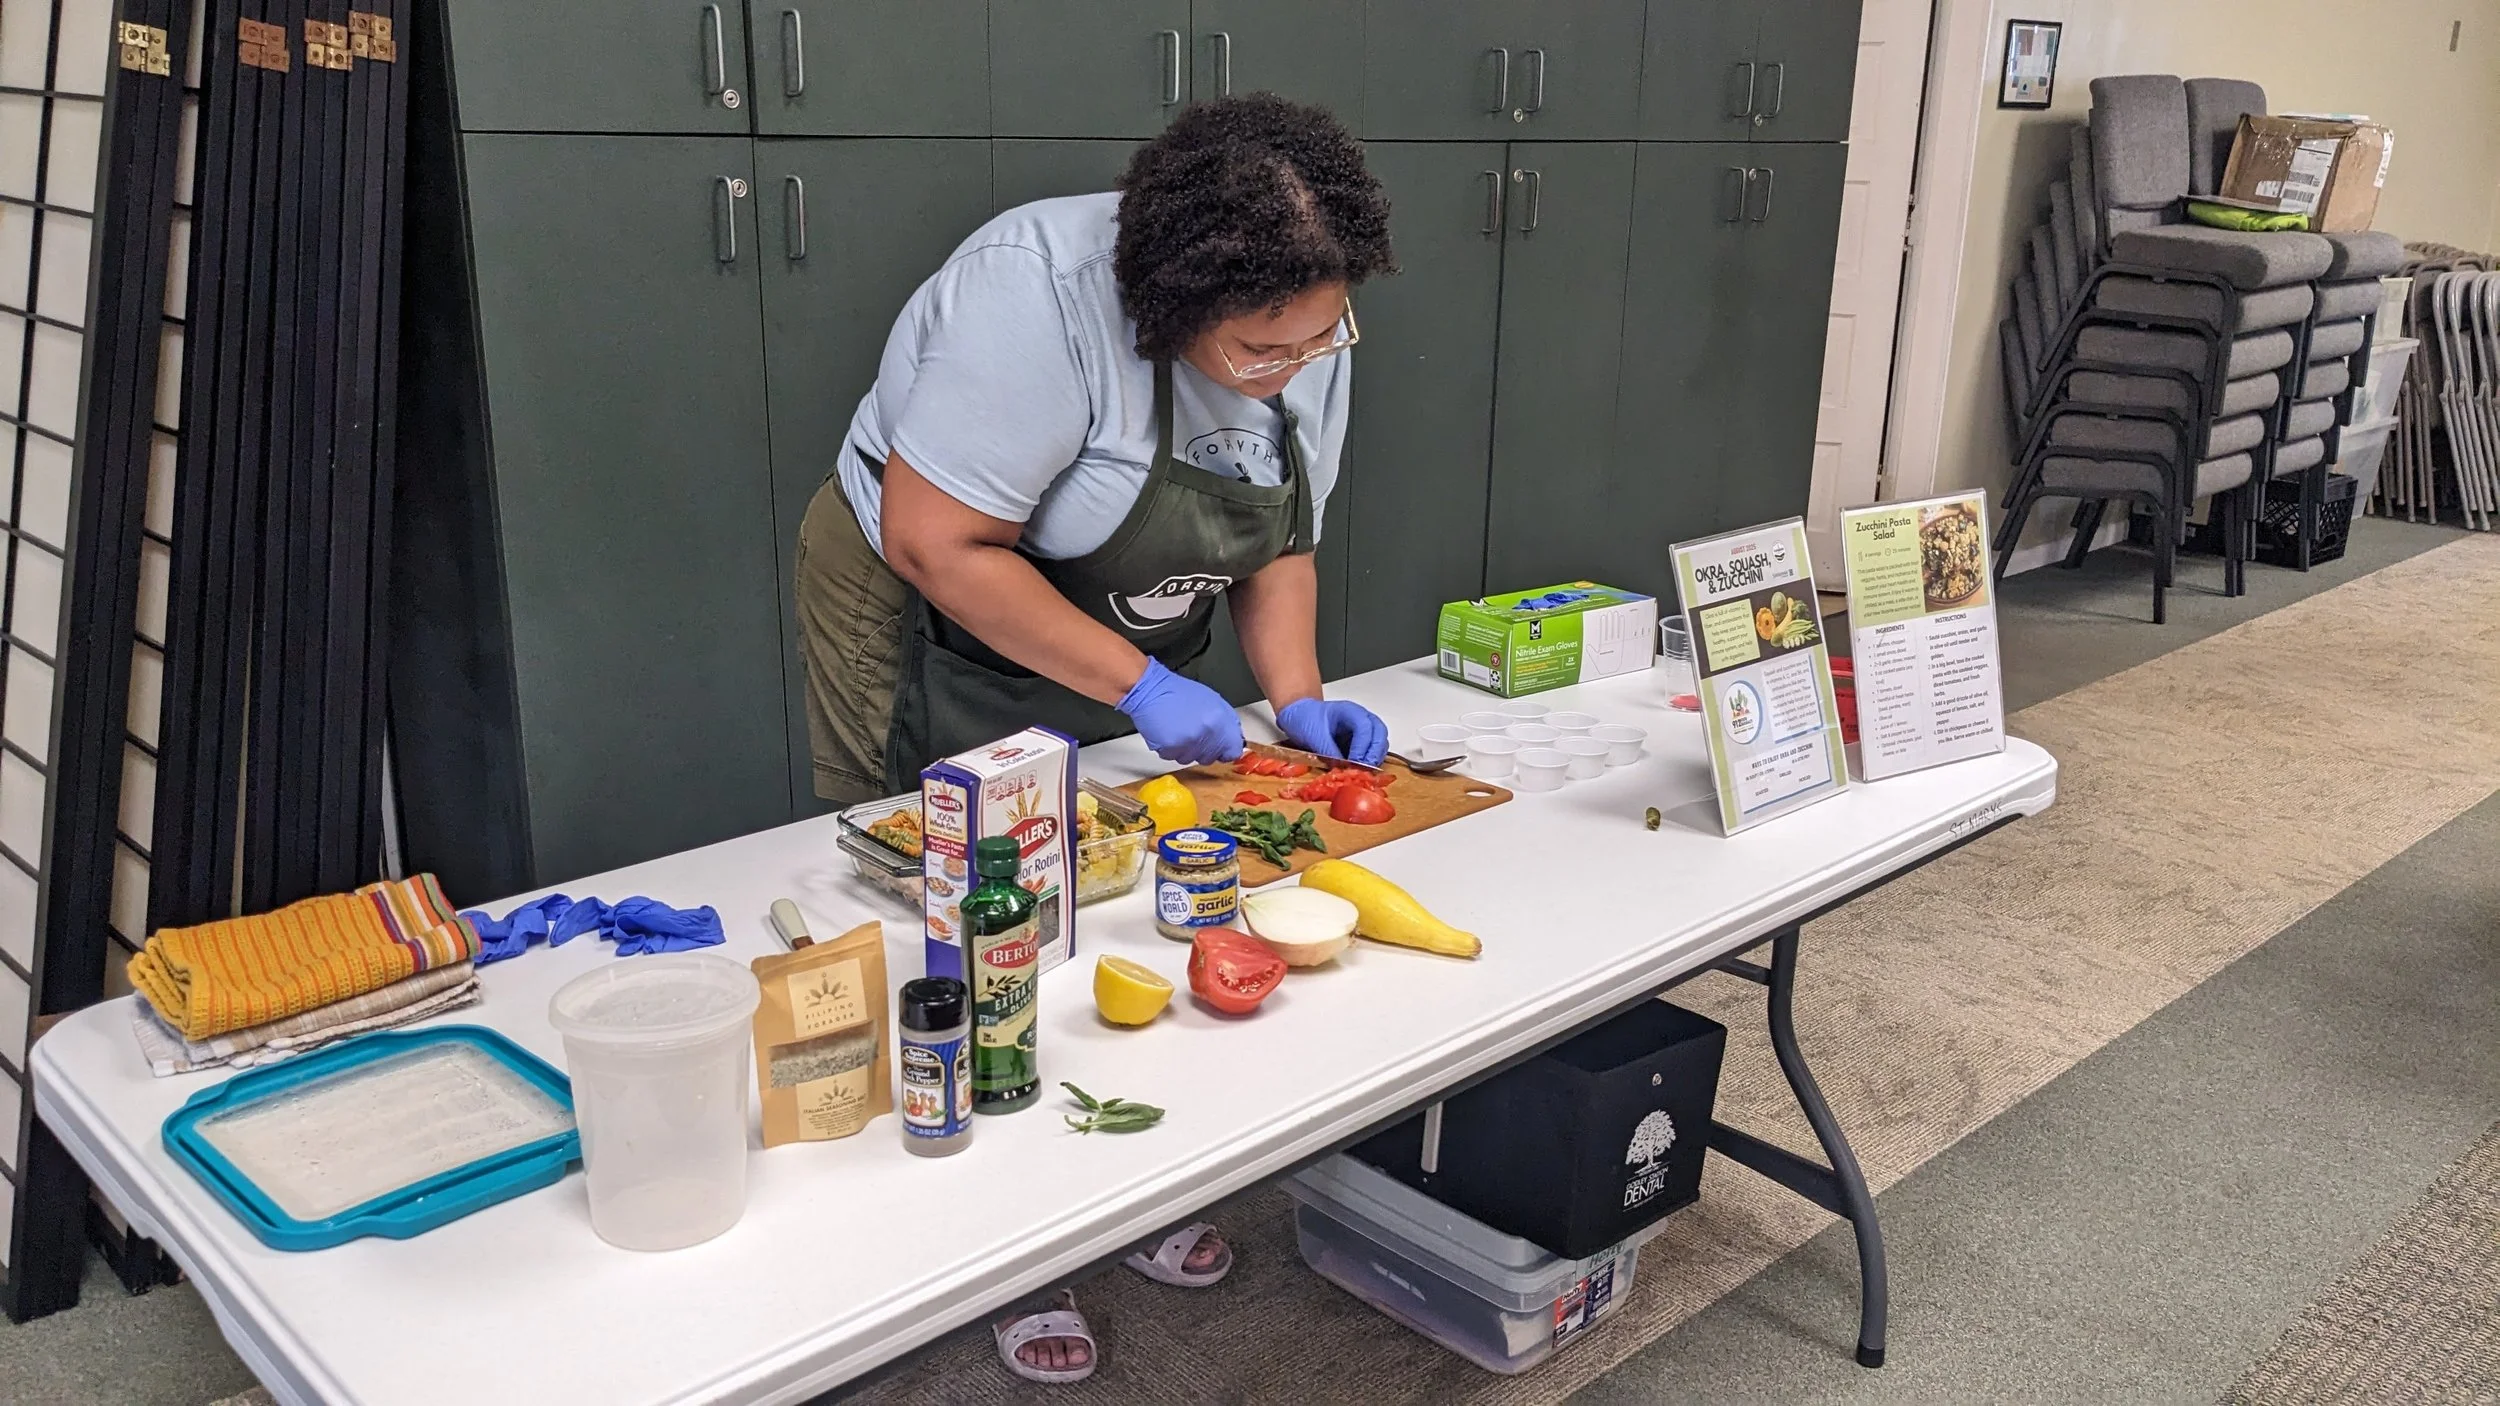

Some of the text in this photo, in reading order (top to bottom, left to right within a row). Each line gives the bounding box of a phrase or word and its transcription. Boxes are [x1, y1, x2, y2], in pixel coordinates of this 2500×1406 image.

[1856, 518, 1911, 532] Zucchini Pasta
[1874, 528, 1895, 540] Salad
[1695, 564, 1727, 582] OKRA,
[1729, 553, 1771, 574] SQUASH,
[1709, 581, 1717, 594] &
[1718, 568, 1763, 592] ZUCCHINI
[1935, 613, 1966, 623] INSTRUCTIONS
[1876, 624, 1905, 634] INGREDIENTS
[1516, 648, 1536, 658] Nitrile
[1538, 646, 1555, 654] Exam
[1556, 641, 1578, 650] Gloves
[931, 796, 960, 810] MUELLER'S
[929, 817, 962, 833] Whole Grain
[937, 812, 956, 824] 100%
[928, 837, 964, 851] Mueller's Pasta
[936, 846, 950, 854] Great
[1035, 849, 1060, 871] Rotini
[1162, 891, 1183, 901] SPICE
[1162, 902, 1187, 913] WORLD
[1196, 896, 1233, 913] garlic
[992, 940, 1037, 964] BERTO
[995, 985, 1028, 1012] EXTRA
[806, 1002, 853, 1019] FILIPINO
[808, 1012, 854, 1030] FORAGER
[904, 1052, 935, 1062] Supreme
[908, 1048, 928, 1058] Spice
[907, 1067, 930, 1077] Ground
[916, 1077, 939, 1085] Pepper
[1624, 1174, 1664, 1206] DENTAL
